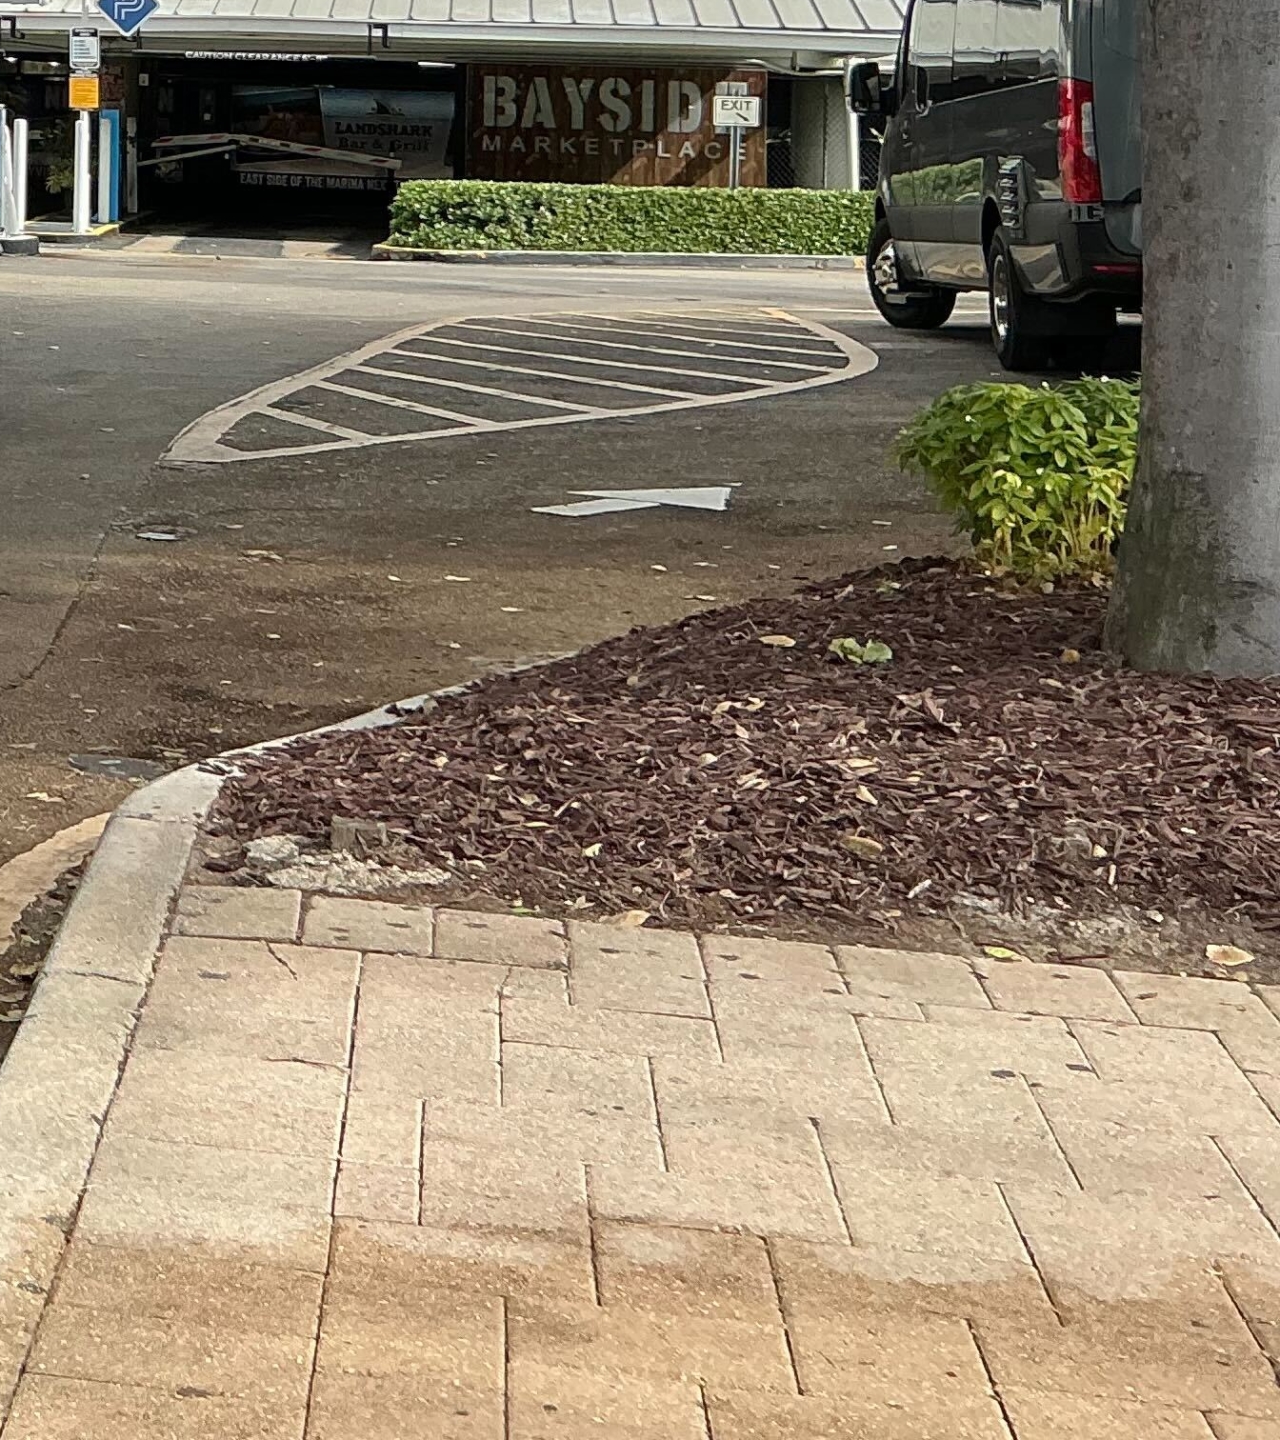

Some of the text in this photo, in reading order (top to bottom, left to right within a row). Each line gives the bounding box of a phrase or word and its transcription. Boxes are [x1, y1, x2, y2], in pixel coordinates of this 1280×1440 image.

[185, 51, 233, 60] CAUTION
[234, 52, 300, 62] CLEARANCE
[721, 99, 753, 111] EXIT
[334, 121, 433, 138] LANDSHARK
[338, 137, 367, 150] Bar
[371, 139, 384, 150] &
[240, 172, 264, 185] EAST
[266, 173, 288, 186] SIDE
[290, 174, 304, 187] OF
[305, 175, 324, 188] THE
[326, 176, 365, 190] MARINA
